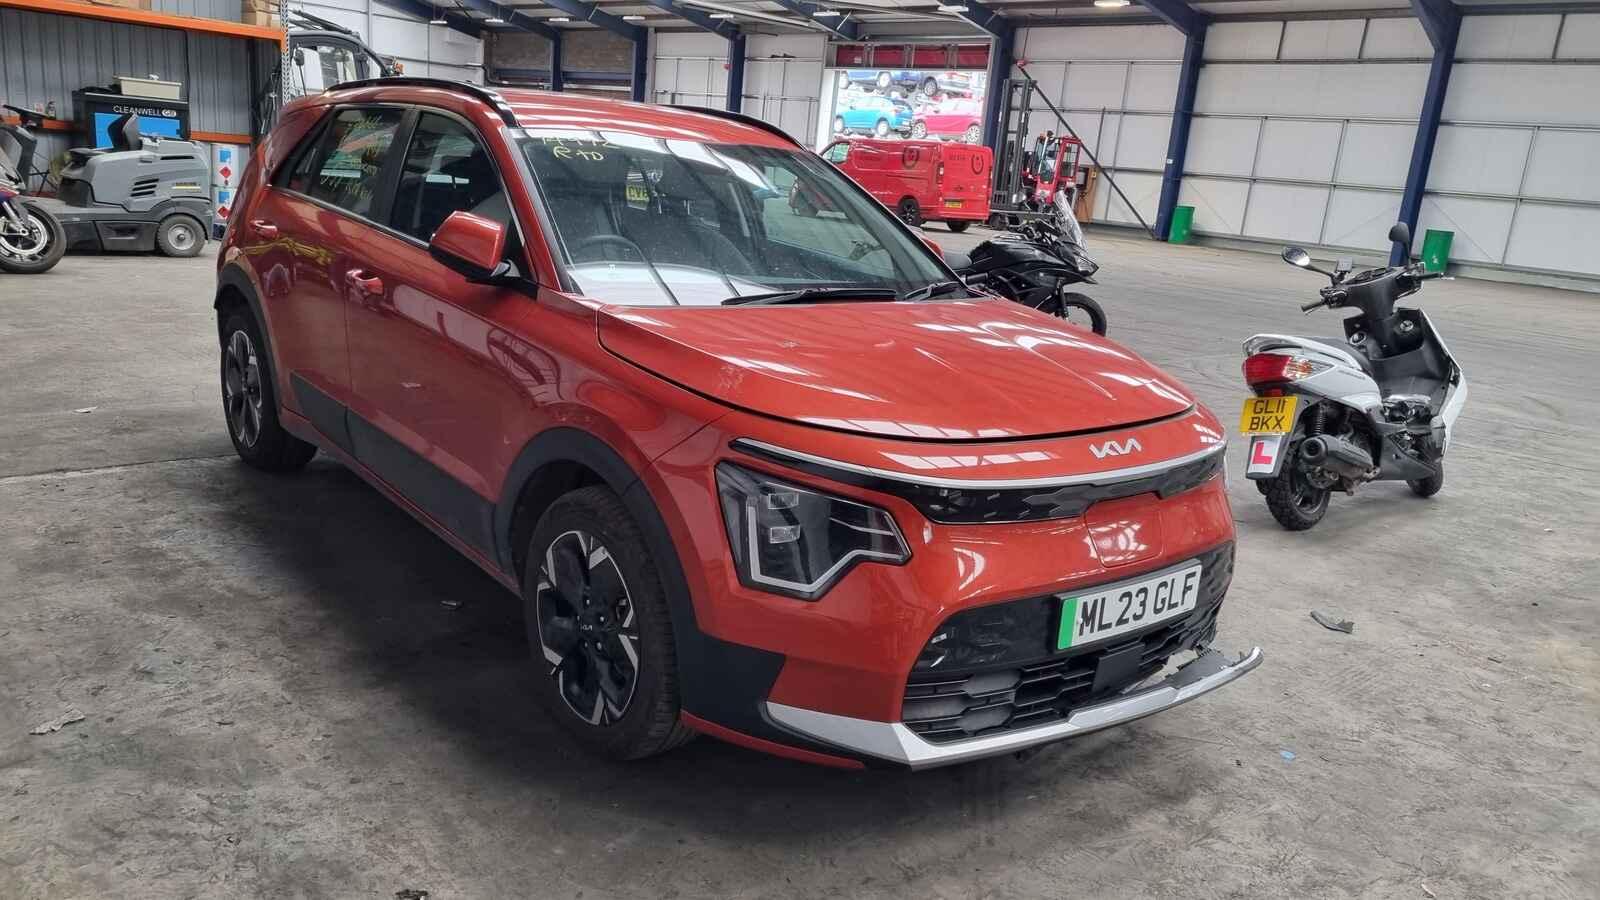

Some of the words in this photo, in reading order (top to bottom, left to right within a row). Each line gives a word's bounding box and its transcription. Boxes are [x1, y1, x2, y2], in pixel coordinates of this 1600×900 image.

[113, 105, 161, 116] CLEANWELL
[1253, 400, 1286, 414] GL11
[1249, 415, 1285, 430] BKX
[1089, 438, 1142, 458] KIA
[1252, 441, 1272, 464] L
[1079, 586, 1148, 636] ML23
[1153, 571, 1196, 615] GLF
